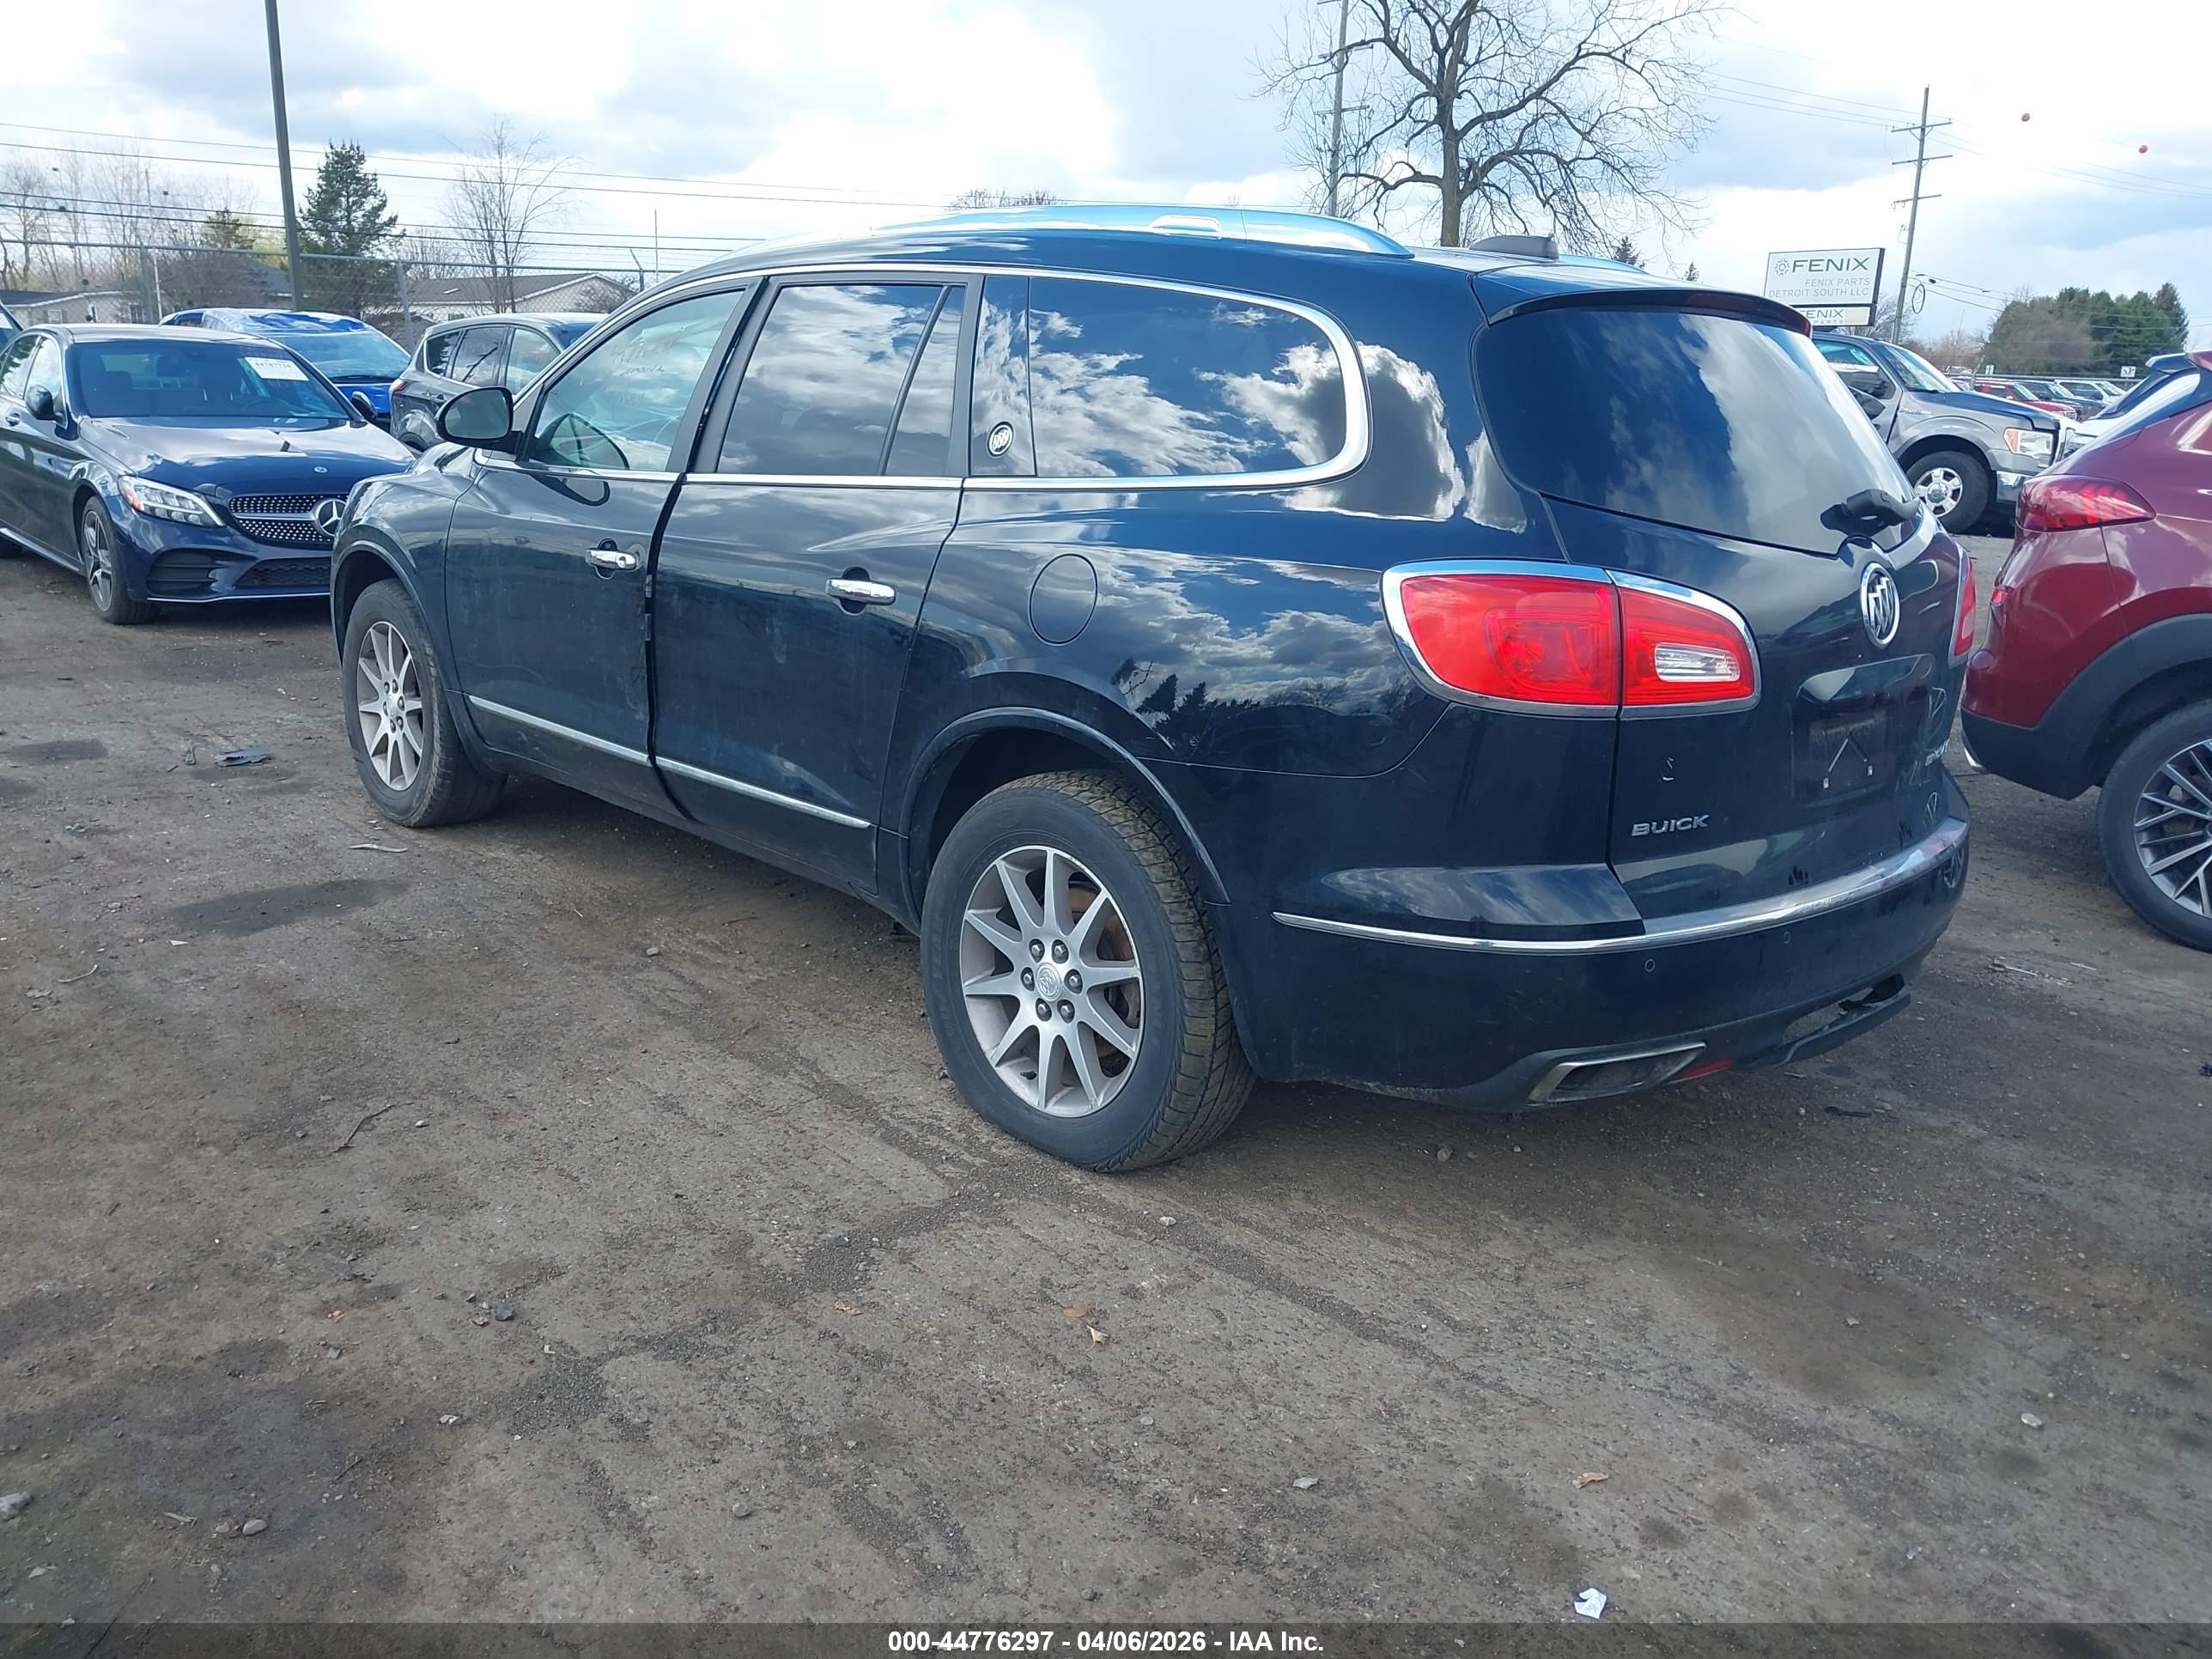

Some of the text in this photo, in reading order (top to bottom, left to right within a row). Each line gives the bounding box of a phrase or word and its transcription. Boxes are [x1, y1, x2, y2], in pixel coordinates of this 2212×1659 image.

[1792, 257, 1870, 273] FENIX
[1805, 277, 1870, 288] FENIX PARTS
[1769, 288, 1869, 298] DETROIT SOUTH LLC
[1632, 814, 1710, 836] BUICK
